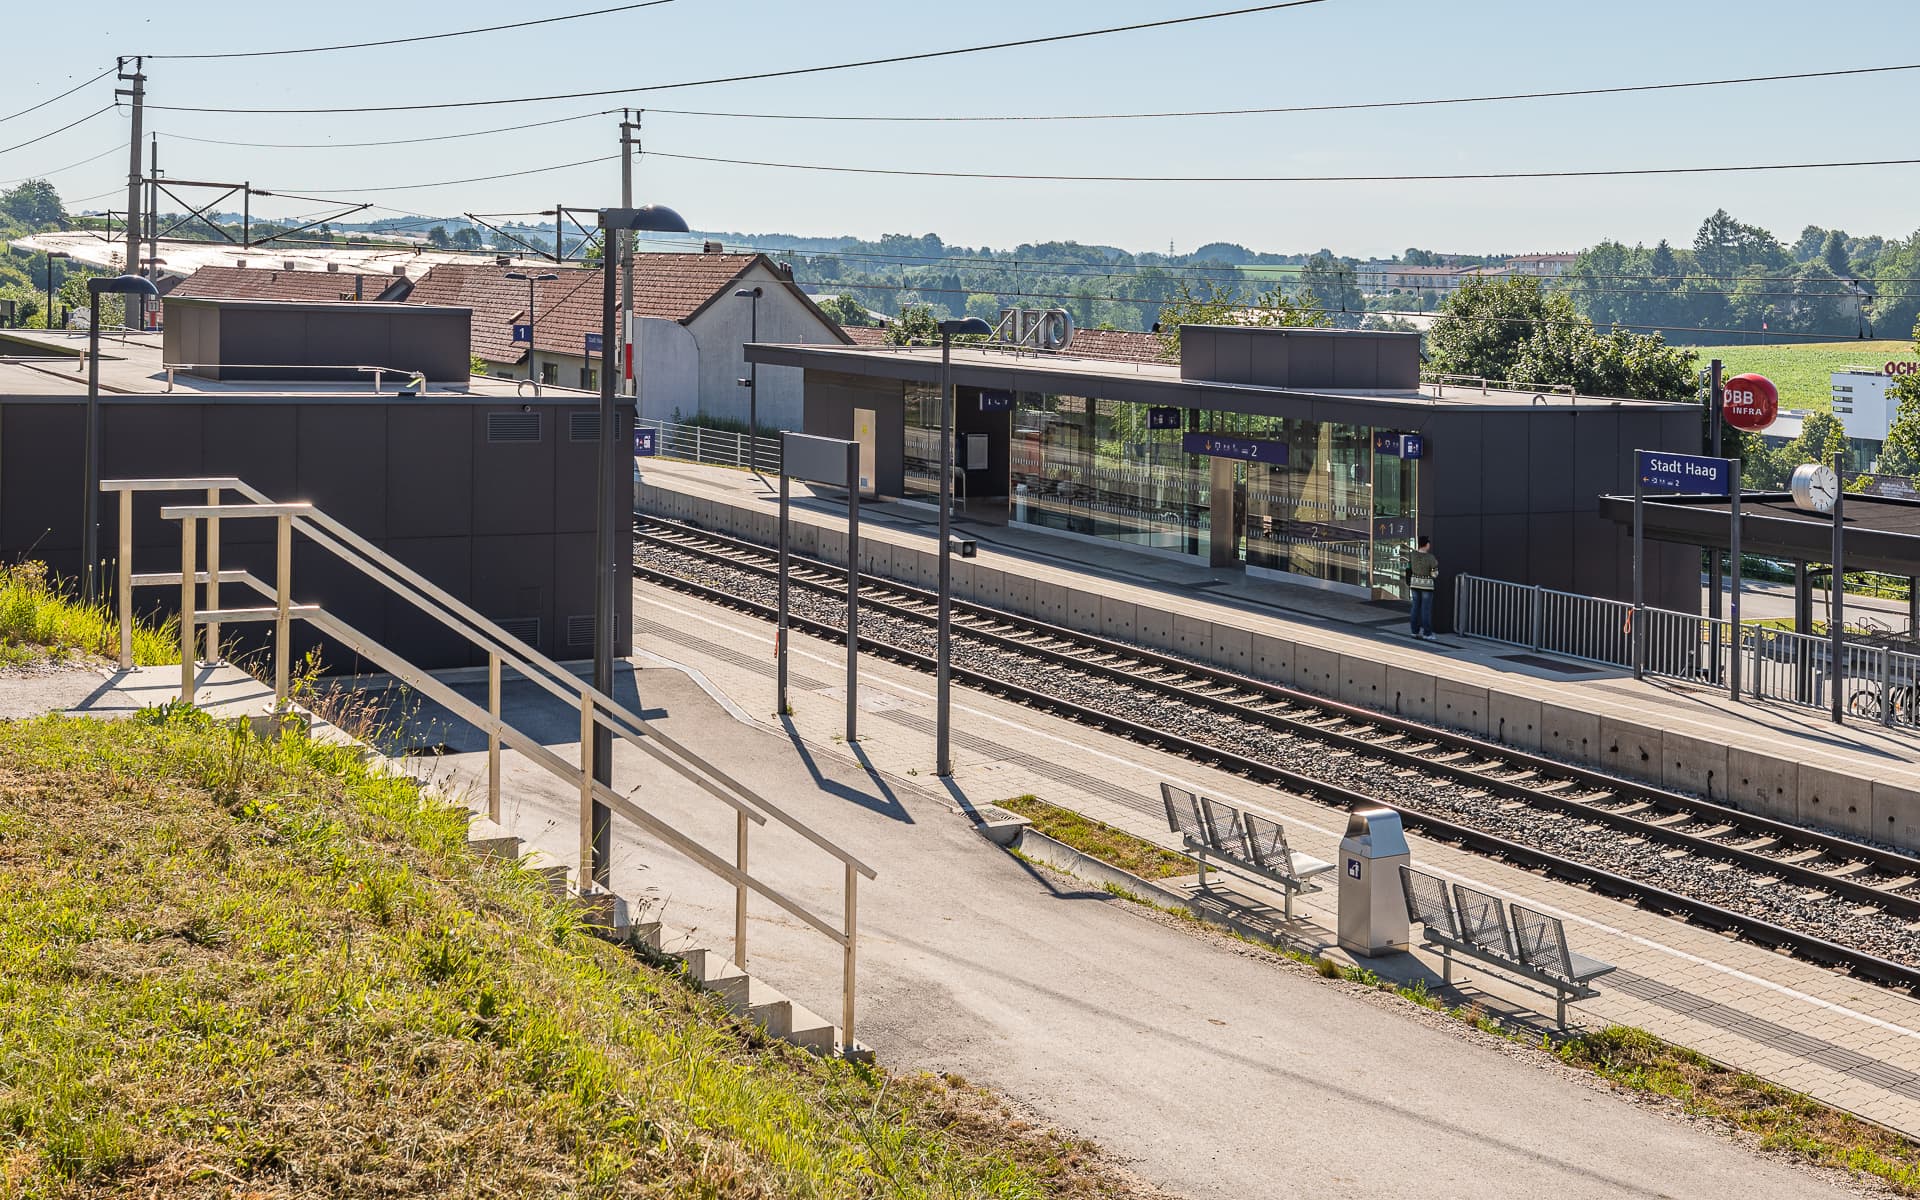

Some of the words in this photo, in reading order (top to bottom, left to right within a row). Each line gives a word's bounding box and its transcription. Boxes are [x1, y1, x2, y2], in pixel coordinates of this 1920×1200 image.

[519, 327, 525, 339] 1
[1885, 361, 1920, 376] OCH
[1724, 389, 1754, 405] ÖBB
[1732, 407, 1763, 416] INFRA
[1251, 444, 1258, 457] 2
[1650, 459, 1682, 474] Stadt
[1685, 462, 1717, 481] Haag
[1311, 526, 1318, 538] 2
